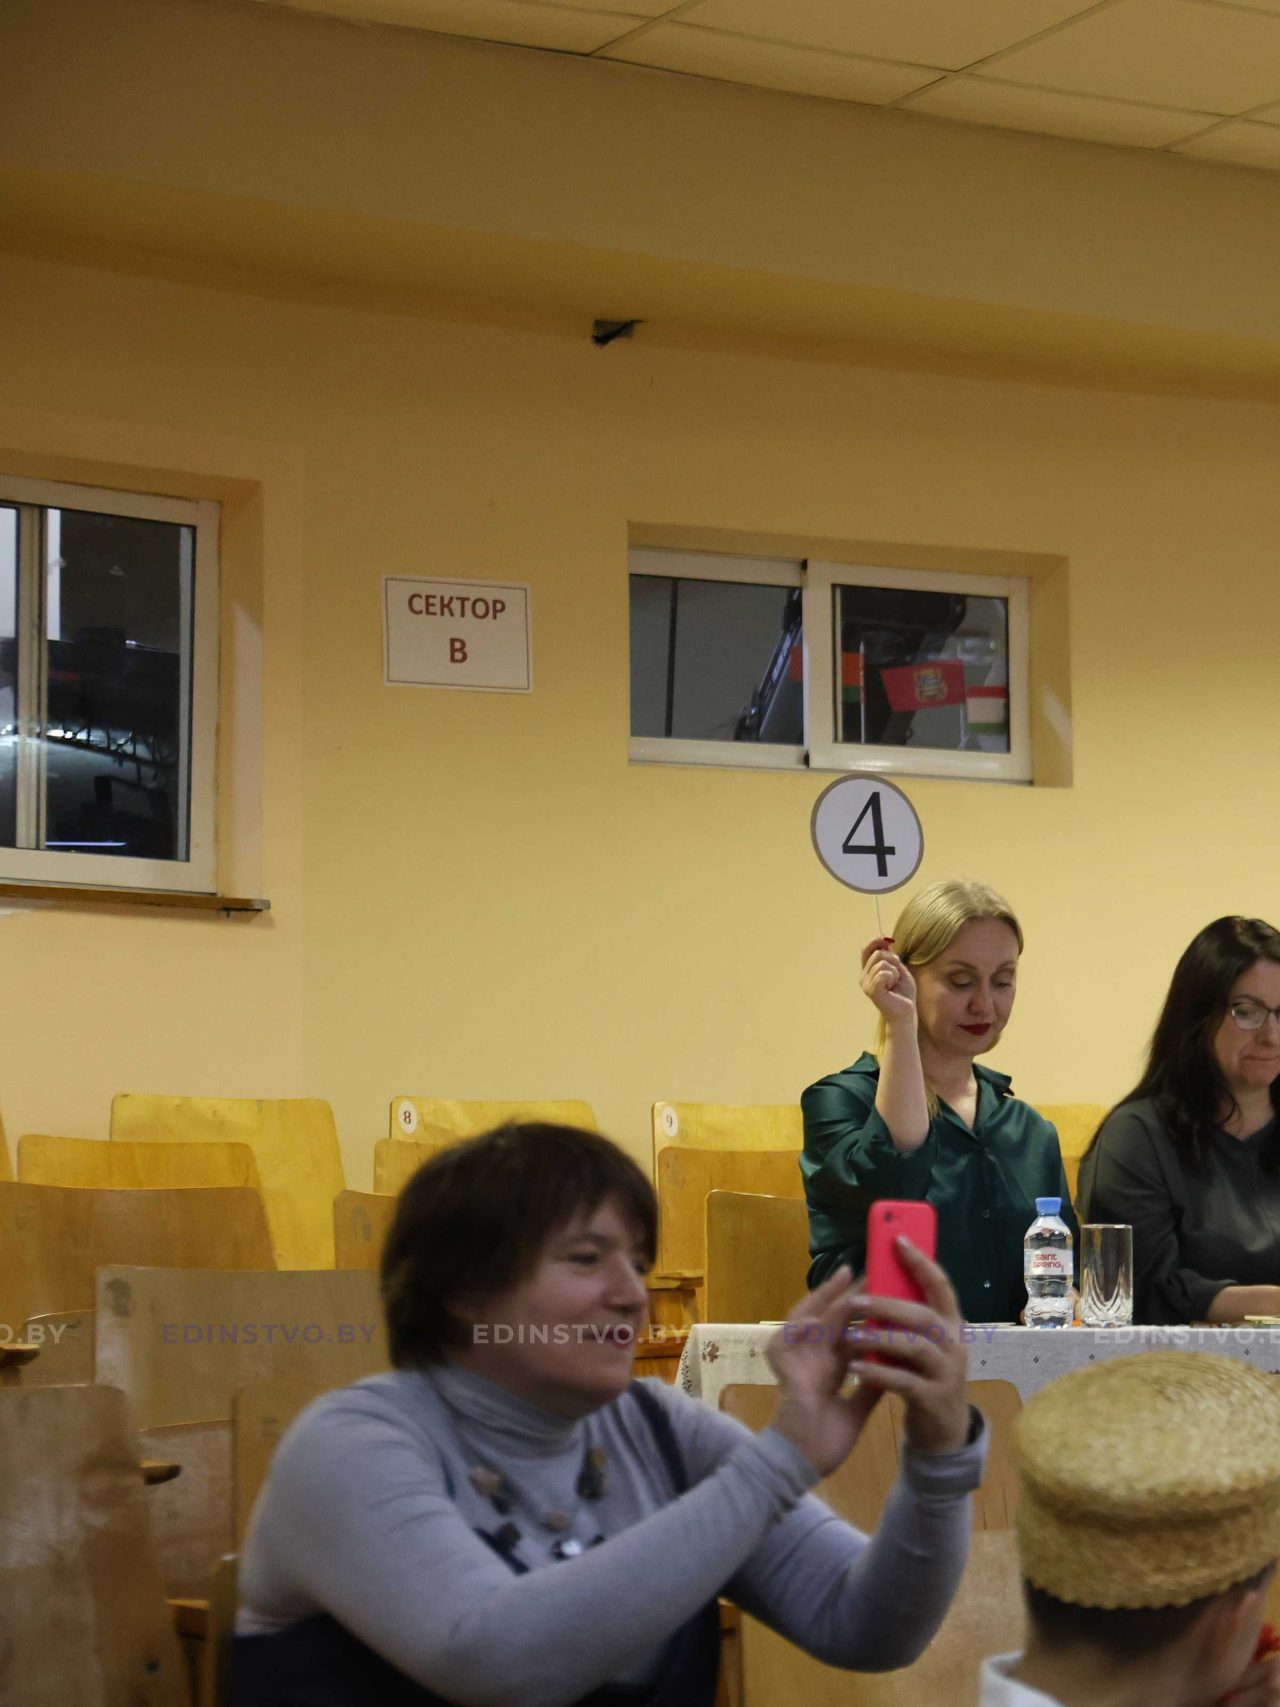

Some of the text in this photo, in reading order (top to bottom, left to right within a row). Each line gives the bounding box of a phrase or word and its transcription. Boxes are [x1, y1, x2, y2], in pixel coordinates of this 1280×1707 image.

[407, 593, 506, 621] СЕКТОР
[449, 637, 468, 664] В
[842, 791, 896, 877] 4
[403, 1110, 412, 1125] 8
[665, 1114, 673, 1128] 9
